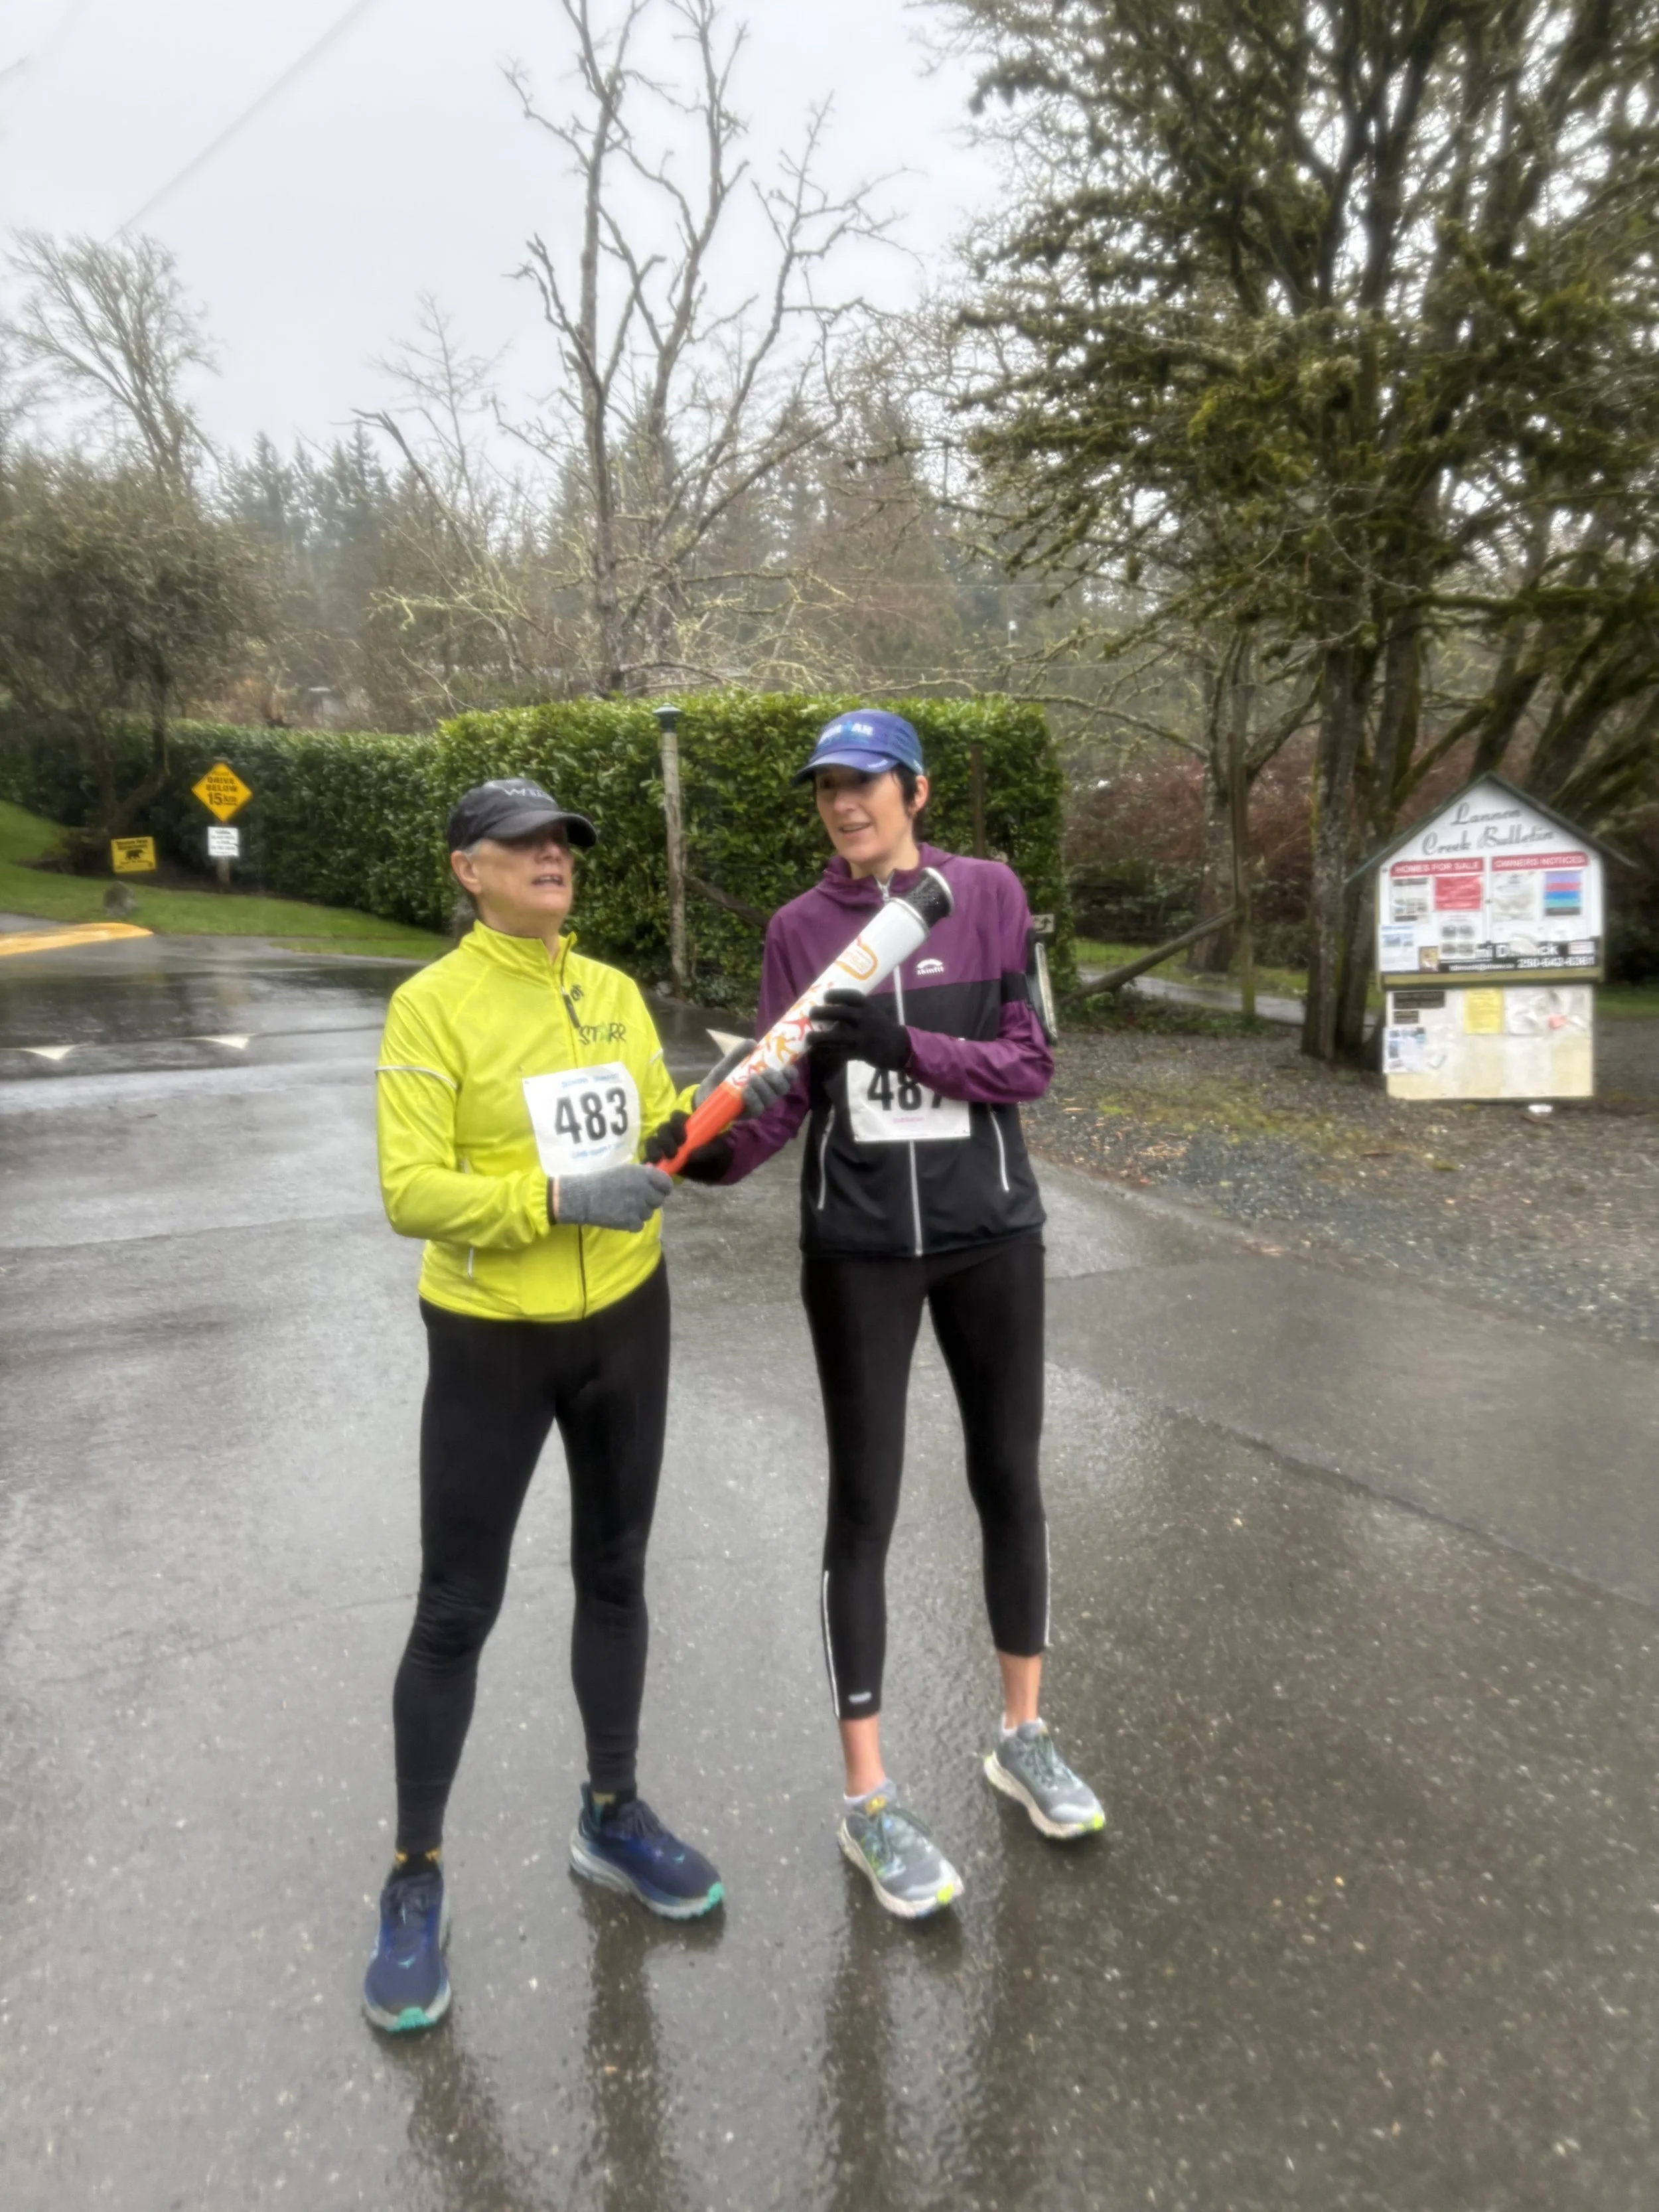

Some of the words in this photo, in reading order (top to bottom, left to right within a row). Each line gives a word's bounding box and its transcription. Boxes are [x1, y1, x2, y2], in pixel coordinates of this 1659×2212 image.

[1422, 830, 1471, 855] Creek
[1477, 824, 1554, 849] Bulletin
[1431, 862, 1453, 871] FOR
[1453, 861, 1480, 870] SALE
[917, 966, 944, 975] skinfit
[555, 1086, 628, 1144] 483
